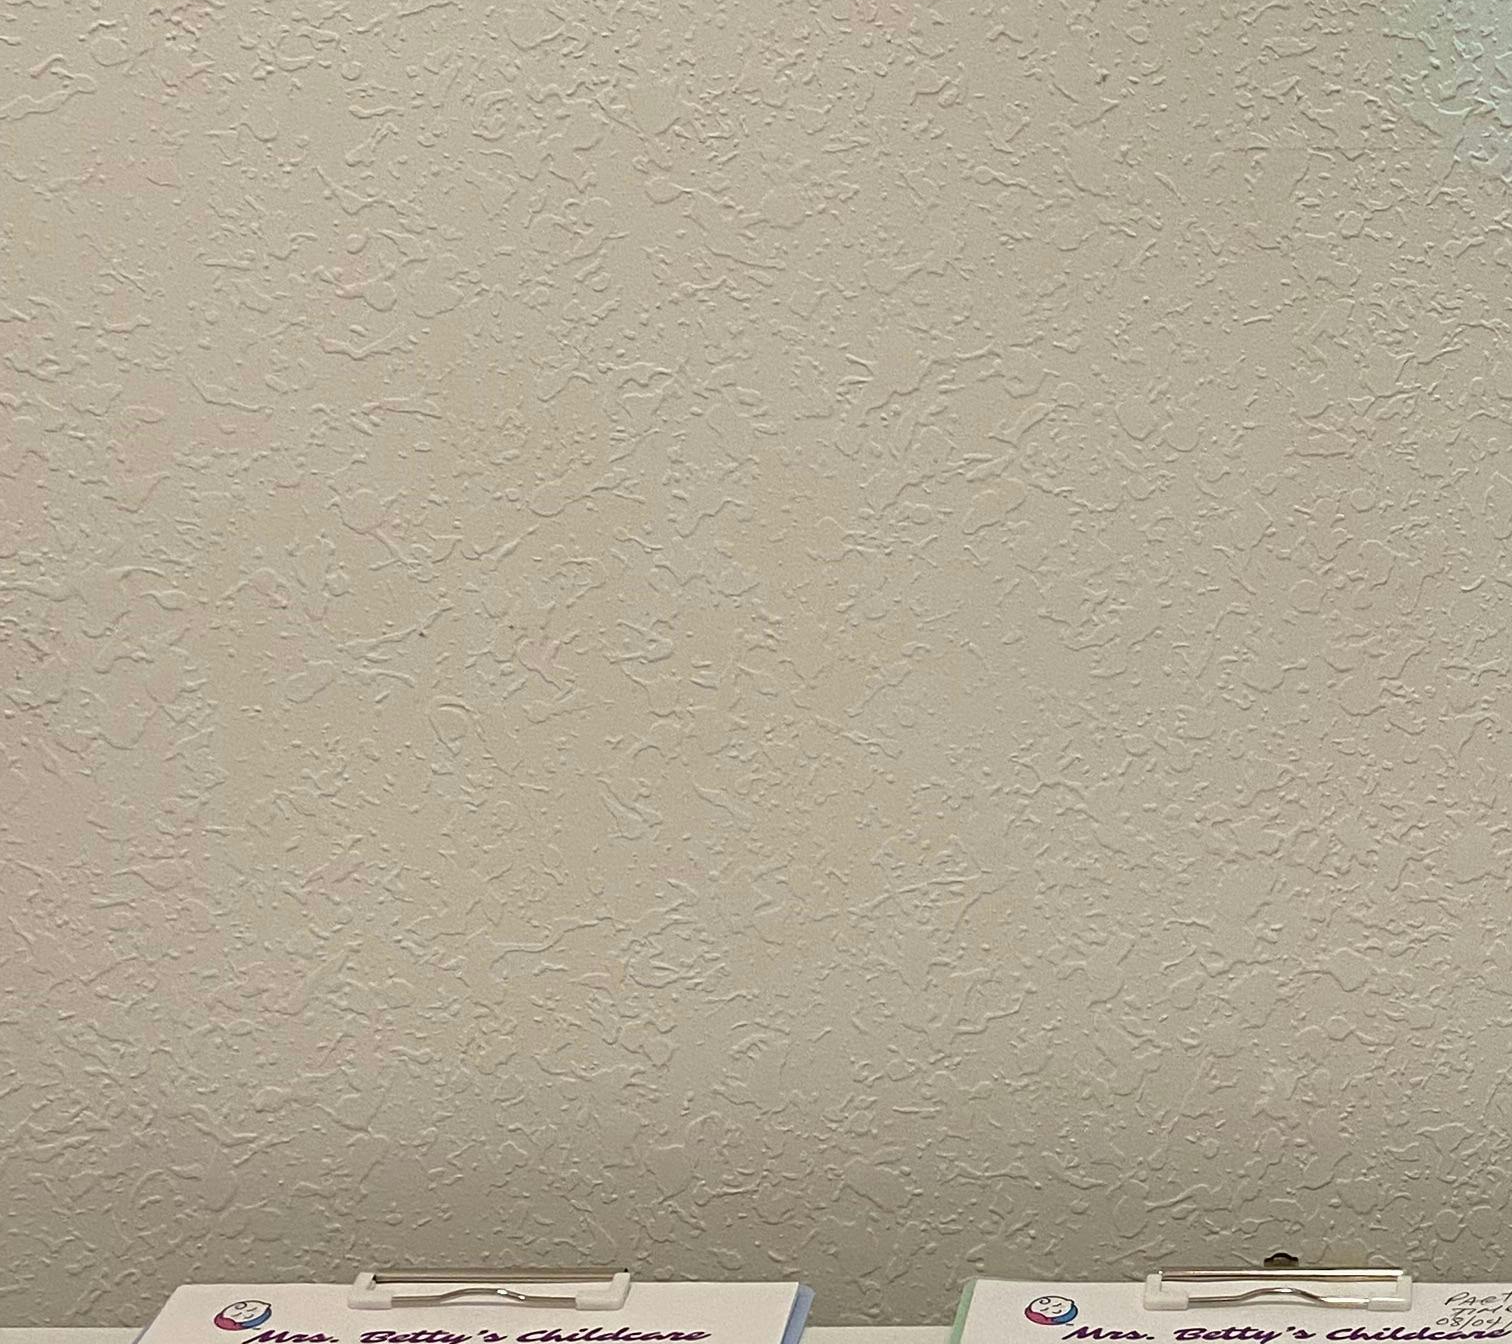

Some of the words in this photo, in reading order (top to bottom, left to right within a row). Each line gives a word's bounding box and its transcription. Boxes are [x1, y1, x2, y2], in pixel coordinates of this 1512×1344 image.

[241, 1329, 339, 1344] Mrs.
[516, 1327, 712, 1343] Childcare
[1062, 1326, 1155, 1341] Mrs.
[1173, 1326, 1317, 1344] Betty's
[1326, 1327, 1512, 1342] Childcare
